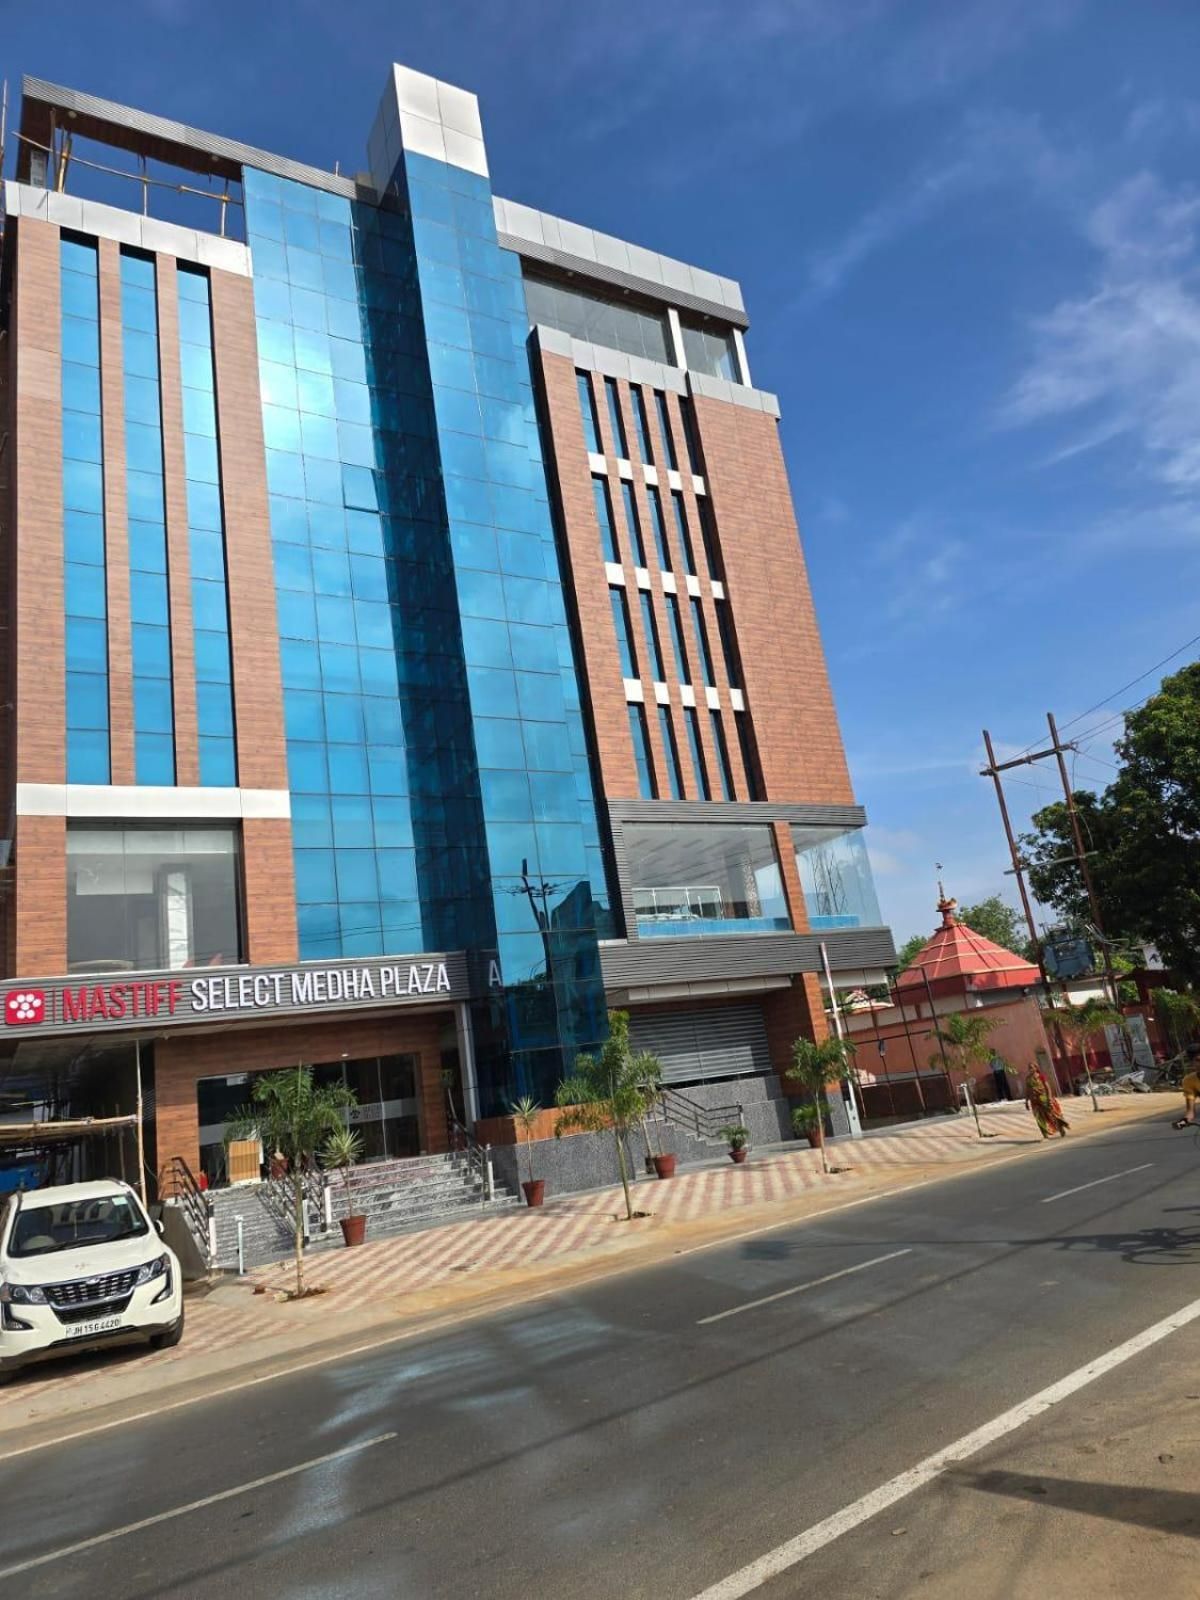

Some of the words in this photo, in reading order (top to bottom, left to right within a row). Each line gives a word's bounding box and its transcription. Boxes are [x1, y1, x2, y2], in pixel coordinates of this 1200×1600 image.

[63, 979, 183, 1021] MASTIFF
[191, 973, 285, 1012] SELECT
[291, 968, 377, 1004] MEDHA
[380, 962, 451, 997] PLAZA
